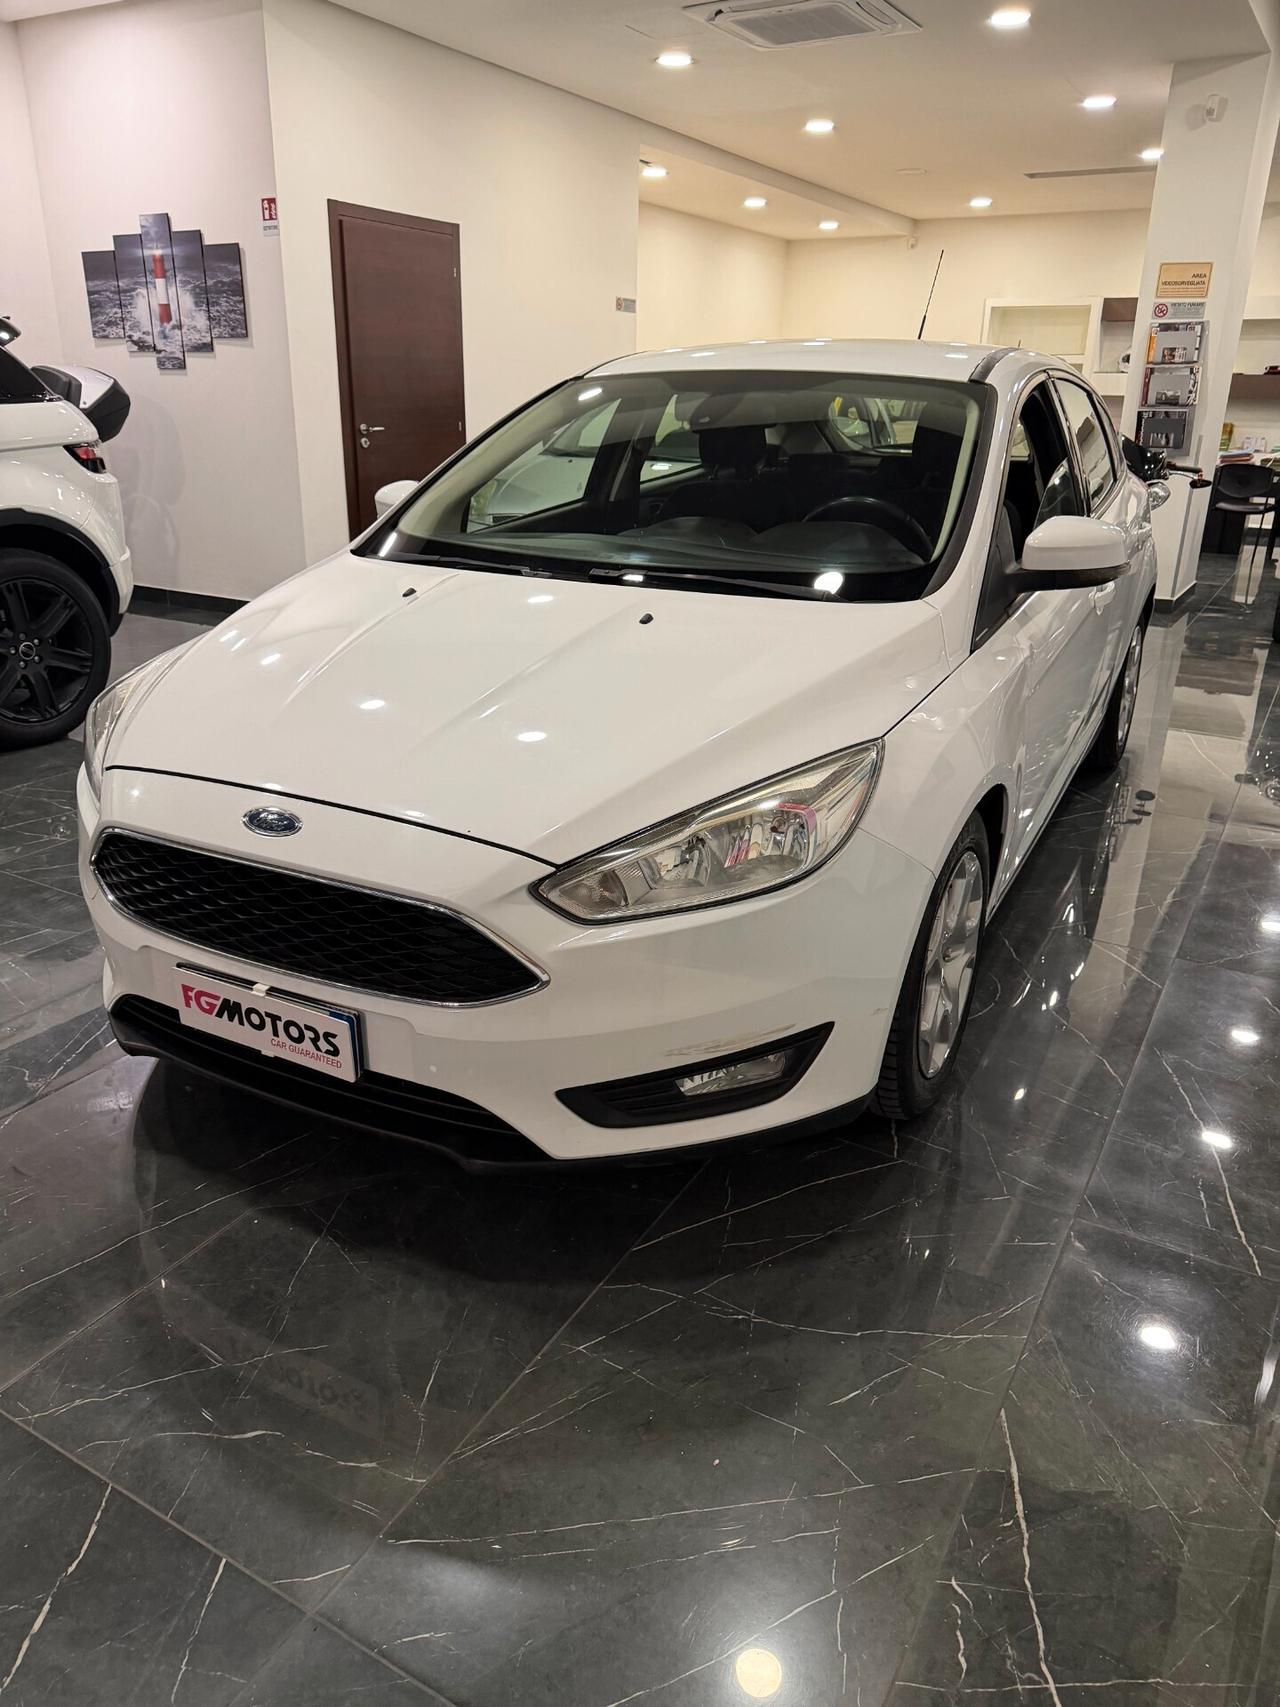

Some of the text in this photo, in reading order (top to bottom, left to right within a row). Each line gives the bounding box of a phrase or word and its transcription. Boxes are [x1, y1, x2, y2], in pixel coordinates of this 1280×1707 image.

[181, 984, 340, 1057] FGMOTORS
[270, 1038, 342, 1069] CAR GUARANTEED
